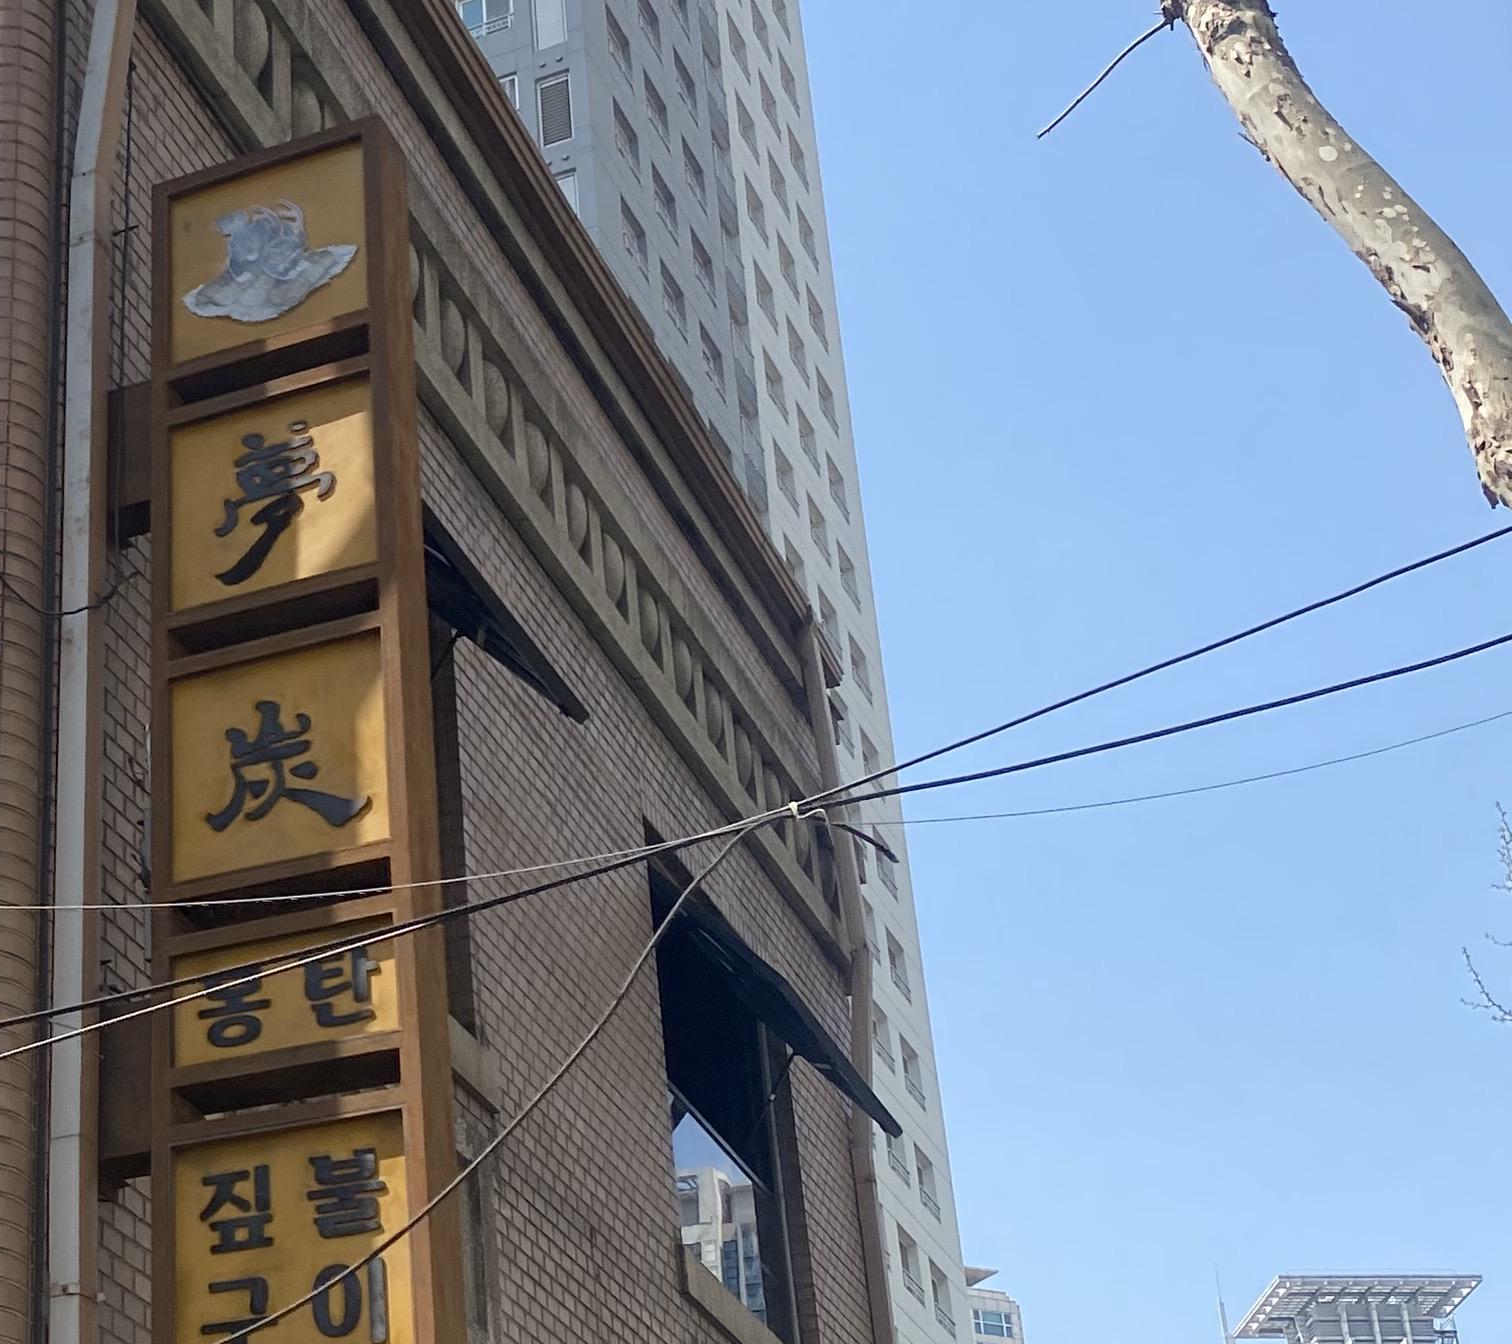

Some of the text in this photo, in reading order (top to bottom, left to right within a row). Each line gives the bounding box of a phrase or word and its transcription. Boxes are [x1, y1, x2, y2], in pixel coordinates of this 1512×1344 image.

[213, 419, 338, 586] 夢
[205, 699, 373, 833] 炭
[197, 945, 384, 1048] 몽탄
[199, 1148, 387, 1255] 짚불
